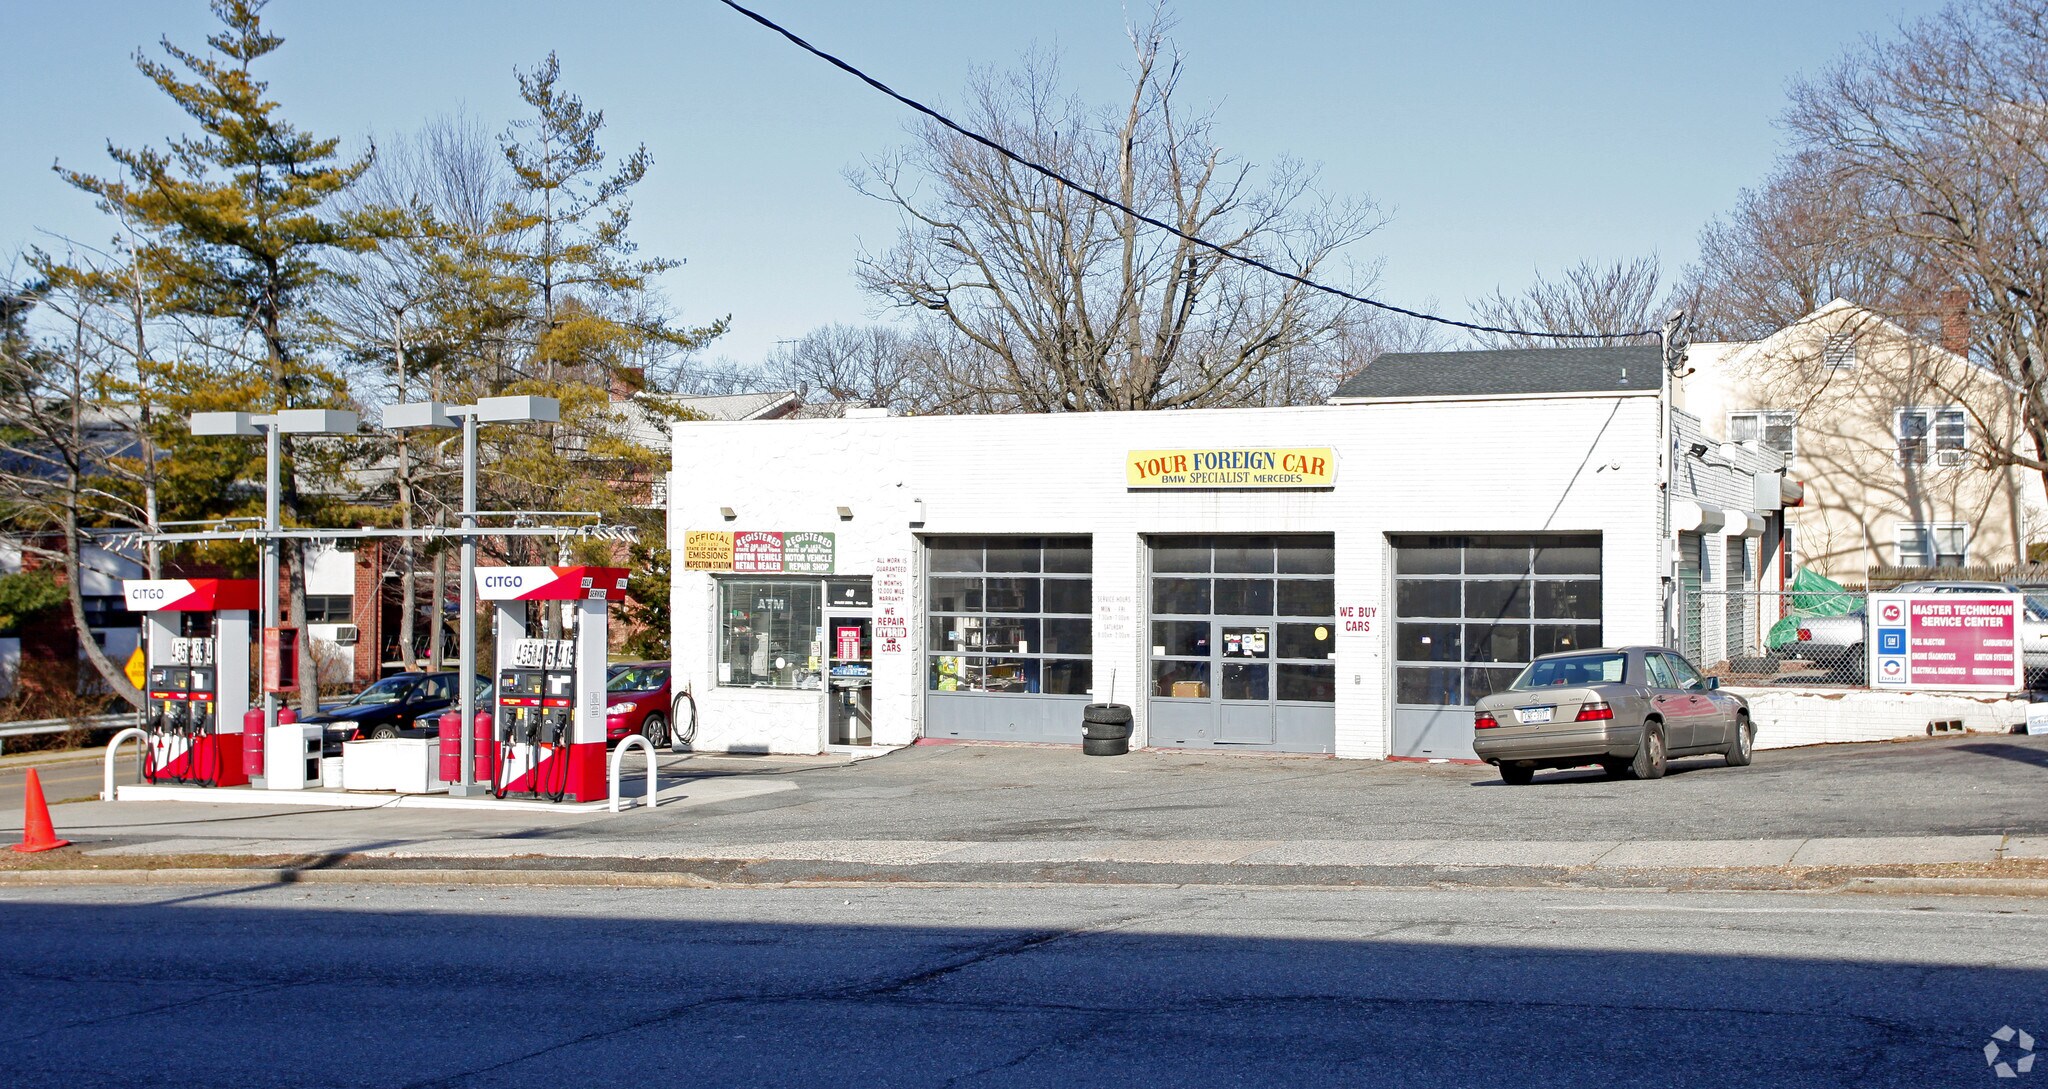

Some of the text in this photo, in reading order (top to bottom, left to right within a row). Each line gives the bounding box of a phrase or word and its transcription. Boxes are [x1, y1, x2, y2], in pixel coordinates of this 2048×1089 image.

[1134, 451, 1325, 478] YOUR FOREIGN CAR
[1161, 472, 1302, 483] BMW SPECIALIST MERCEDES
[689, 533, 730, 545] OFFICIAL
[736, 532, 781, 547] REGISTERED
[785, 533, 832, 548] REGISTERED
[734, 552, 782, 562] MOTOR VEHICLE
[736, 562, 780, 570] RETAIL DEALER
[486, 576, 522, 588] CITGO
[132, 589, 164, 600] CITGO
[846, 589, 855, 598] 40
[758, 599, 784, 610] ATM
[1340, 607, 1376, 617] WE BUY
[1885, 608, 1898, 616] AC
[1912, 606, 2012, 616] MASTER TECHNICIAN
[878, 618, 904, 626] REPAIR
[1346, 621, 1370, 632] CARS
[1922, 617, 2003, 627] SERVICE CENTER
[876, 628, 904, 637] HYBRID
[882, 644, 902, 652] CARS
